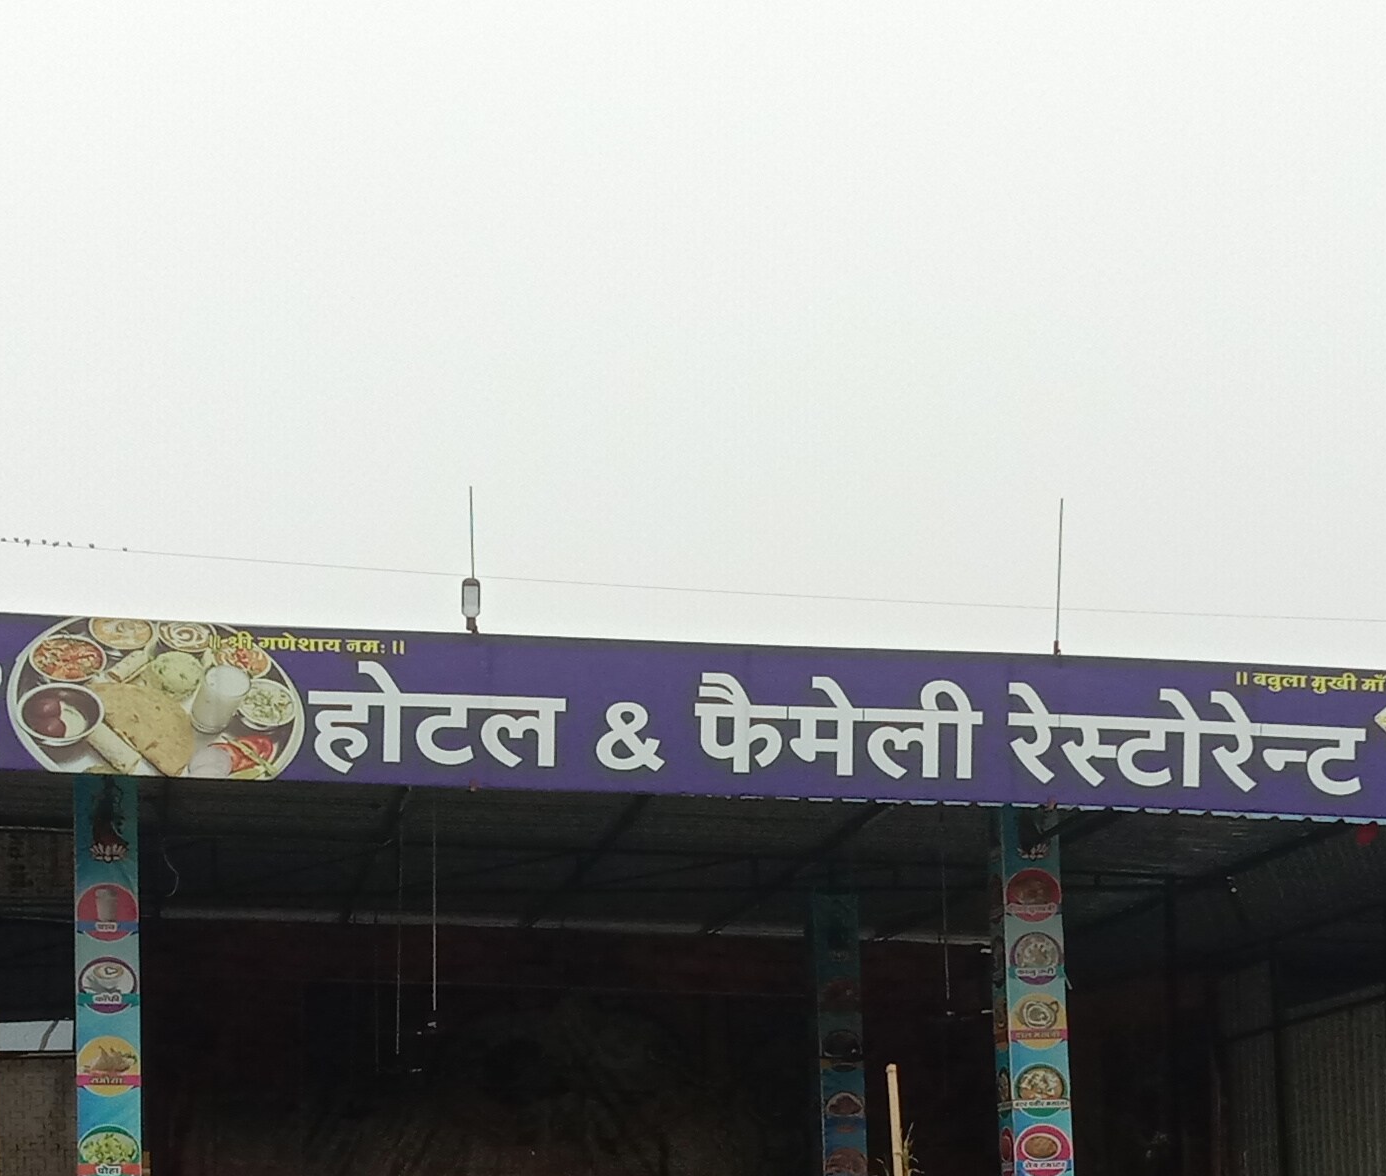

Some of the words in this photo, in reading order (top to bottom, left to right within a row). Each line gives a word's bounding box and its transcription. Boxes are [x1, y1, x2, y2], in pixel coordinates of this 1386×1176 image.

[227, 630, 254, 650] श्री
[258, 632, 342, 652] गणेशाय
[1311, 672, 1358, 694] मुखी
[308, 660, 566, 769] होटल
[595, 699, 665, 772] &
[694, 672, 985, 780] फैमेली
[1006, 681, 1367, 796] रेस्टोरेन्ट
